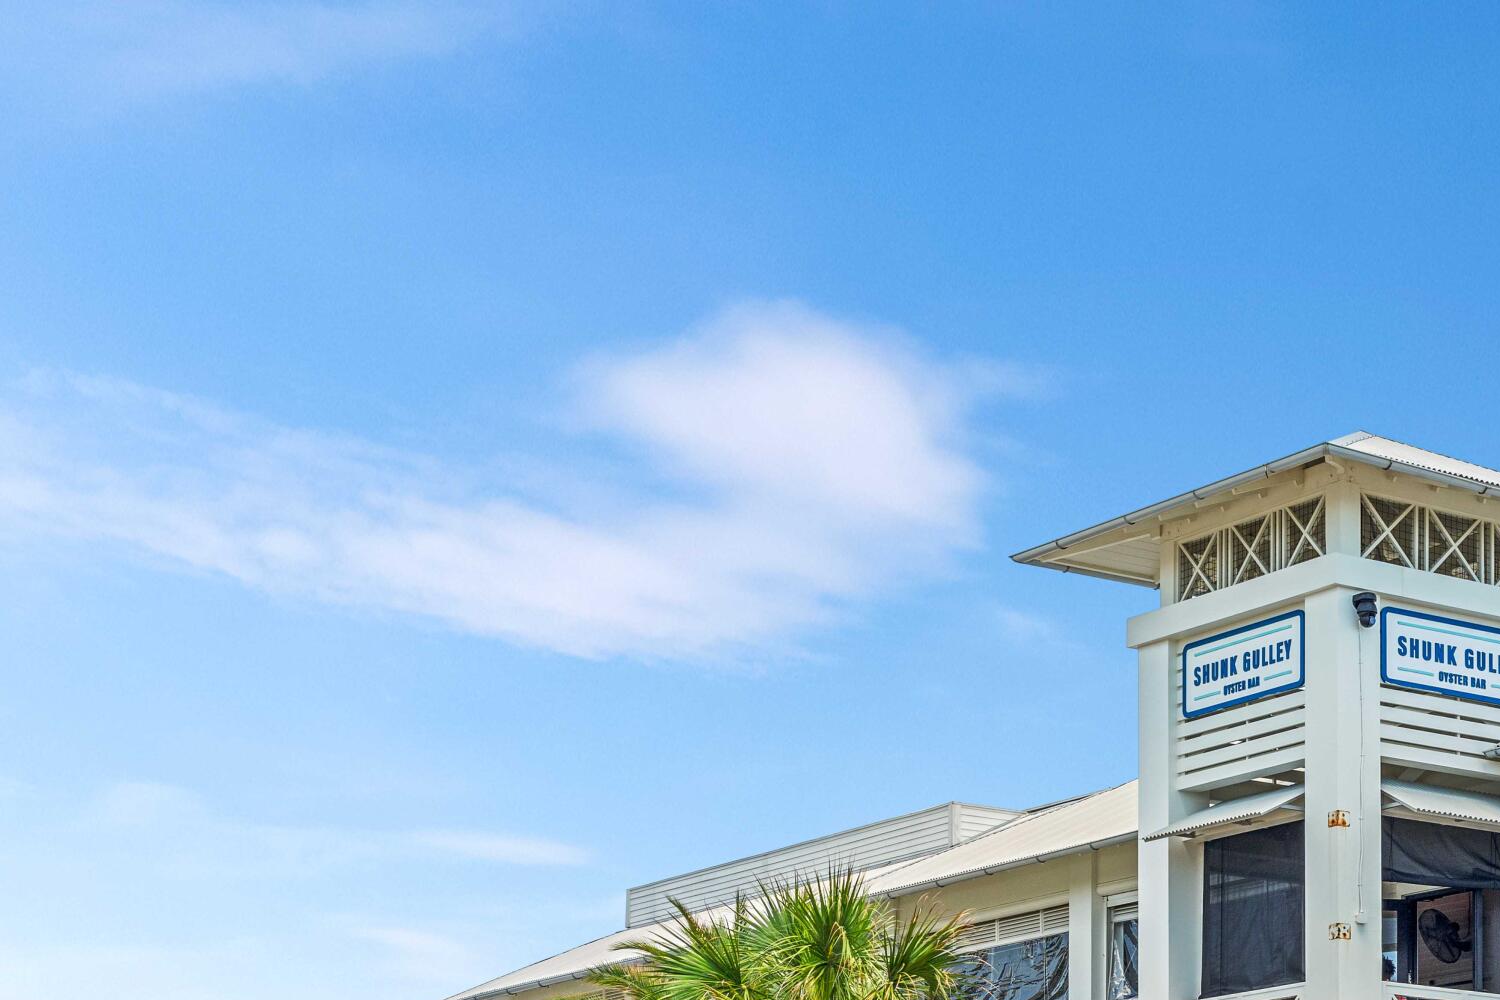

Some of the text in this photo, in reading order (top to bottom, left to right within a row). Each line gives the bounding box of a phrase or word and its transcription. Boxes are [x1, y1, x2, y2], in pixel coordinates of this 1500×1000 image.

[1193, 639, 1292, 687] SHUNK GULLEY
[1397, 635, 1457, 667] SHUNK
[1223, 676, 1260, 696] OYSTER BAR
[1438, 671, 1487, 690] OYSTER BAR
